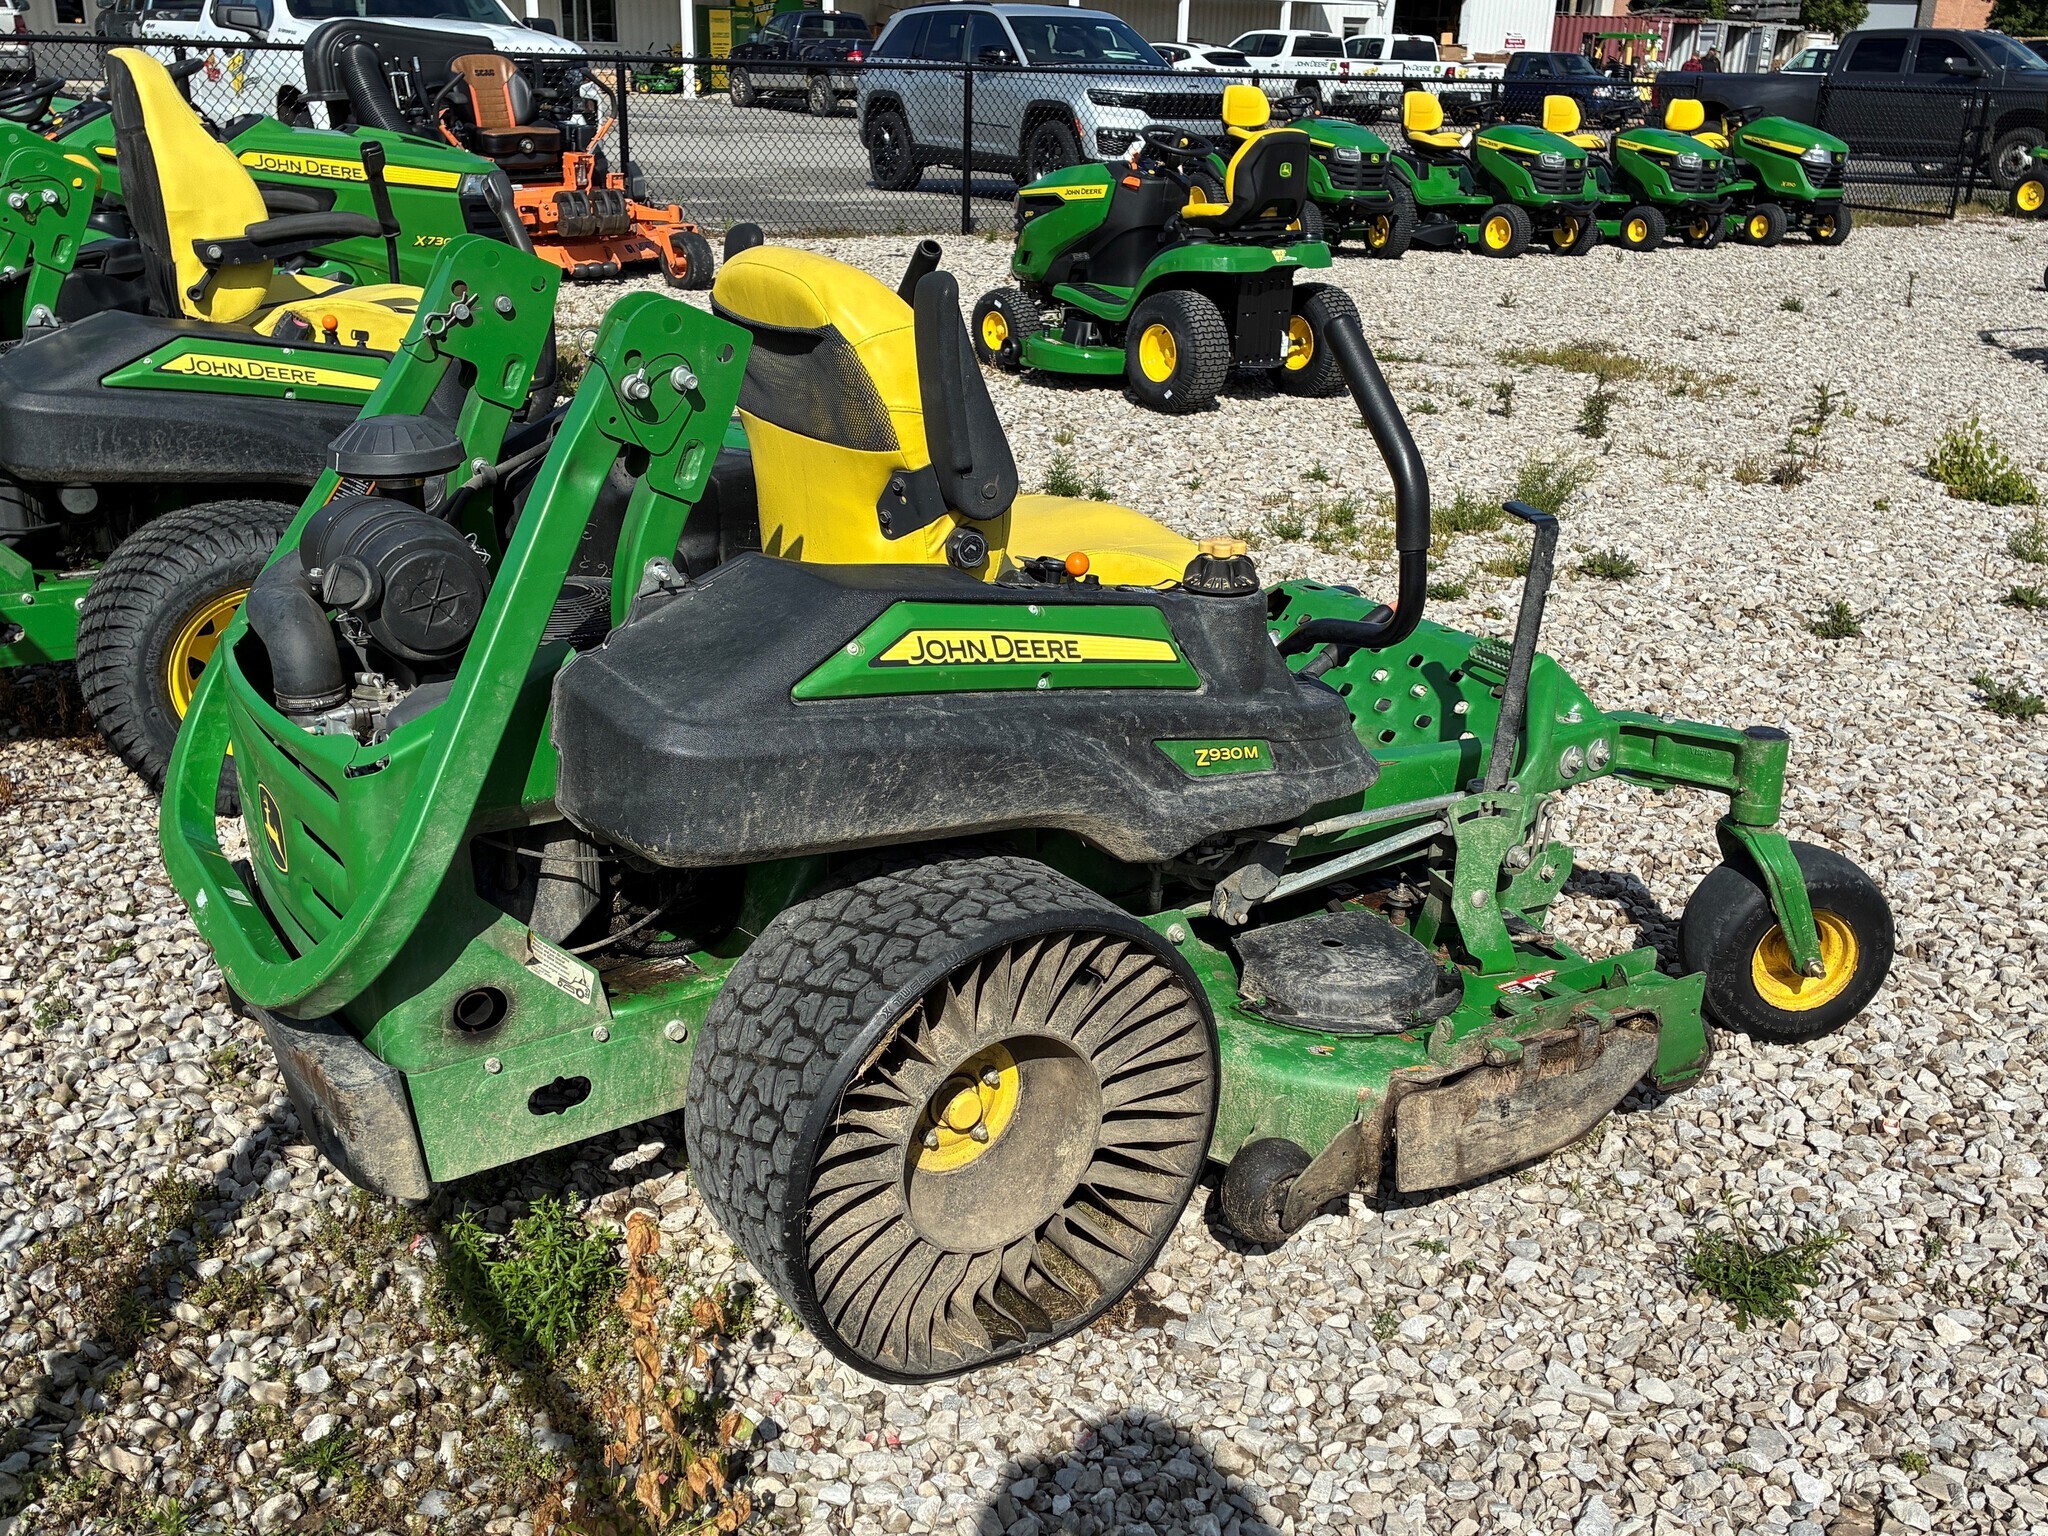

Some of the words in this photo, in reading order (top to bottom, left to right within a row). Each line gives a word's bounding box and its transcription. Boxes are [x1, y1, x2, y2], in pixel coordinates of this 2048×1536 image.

[254, 154, 303, 173] JOHN
[306, 160, 363, 180] DEERE
[1081, 187, 1102, 195] DEERE
[184, 356, 243, 378] JOHN
[249, 361, 317, 383] DEERE
[910, 635, 988, 661] JOHN
[990, 634, 1081, 659] DEERE
[1194, 745, 1259, 767] Z930M
